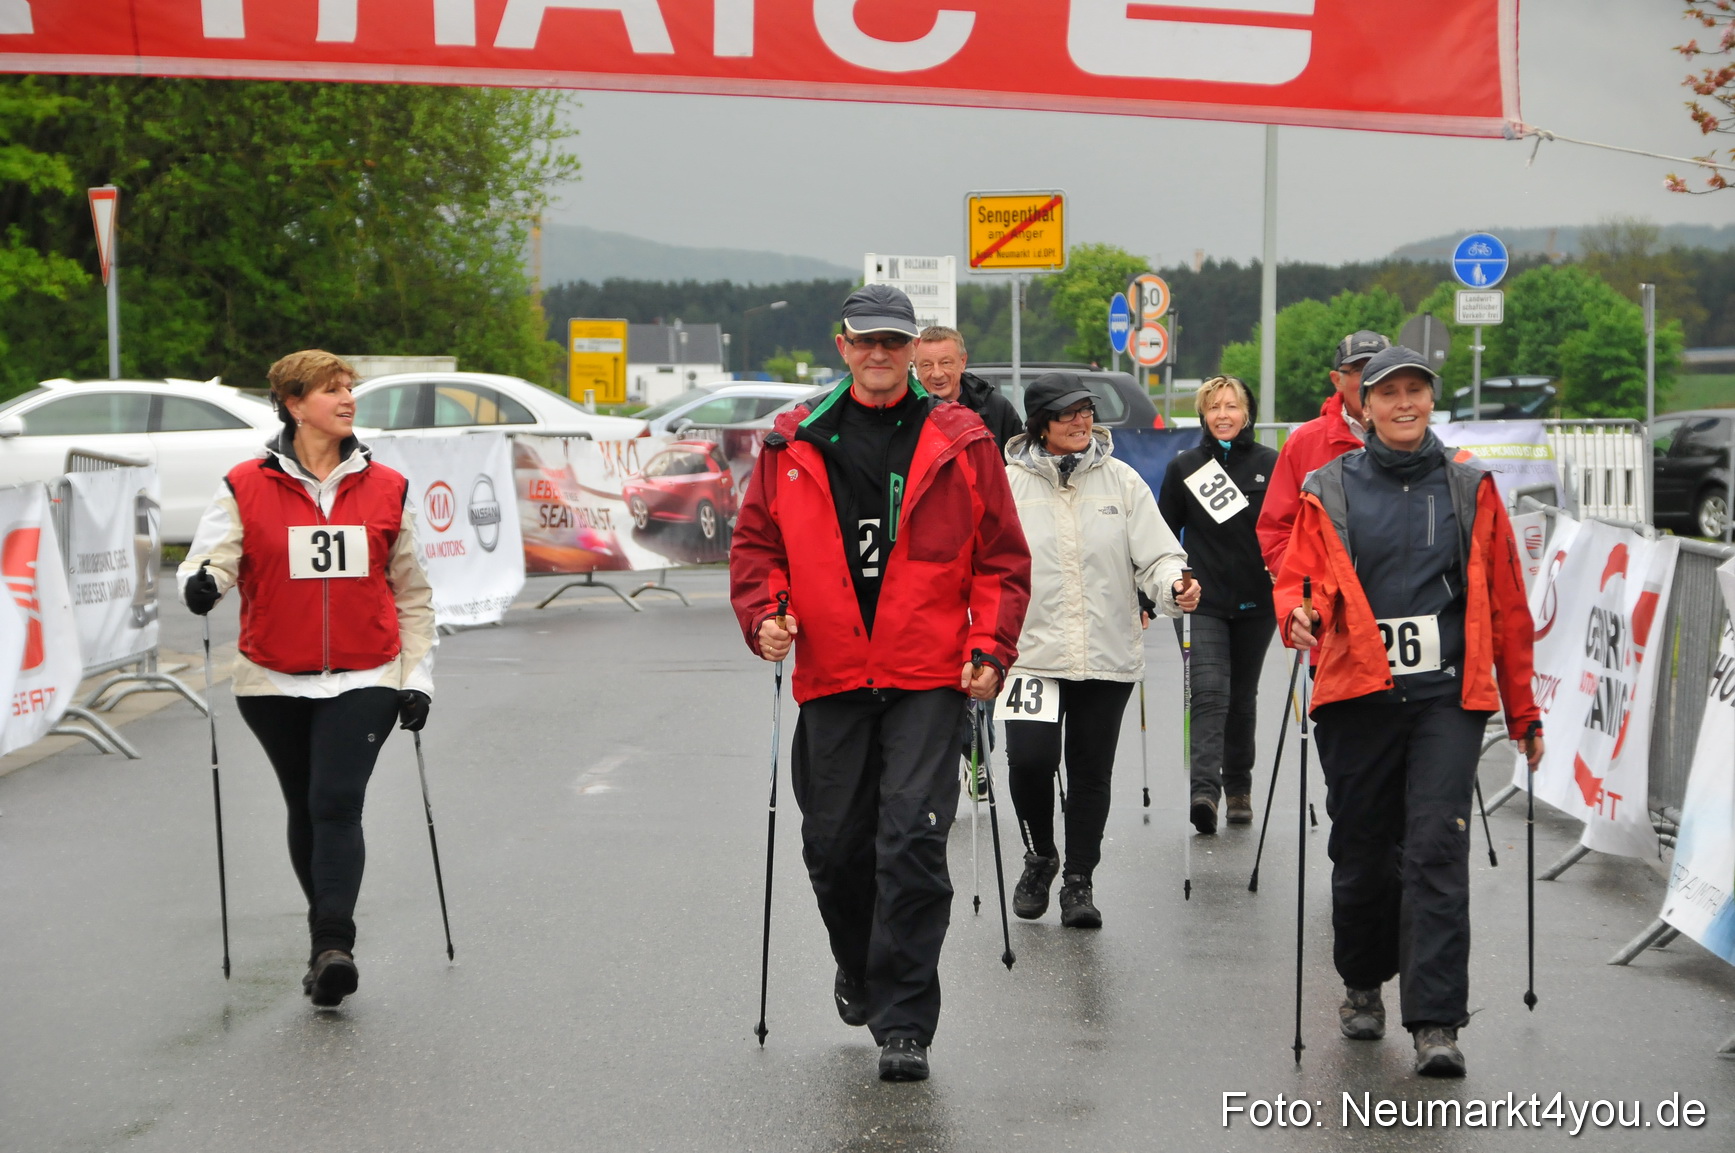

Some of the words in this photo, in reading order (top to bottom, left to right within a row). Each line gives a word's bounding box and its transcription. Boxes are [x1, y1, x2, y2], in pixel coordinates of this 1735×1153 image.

[978, 205, 1055, 227] Sengenthal
[988, 230, 1004, 239] am
[996, 248, 1031, 258] Neumarkt
[1199, 473, 1237, 511] 36
[429, 494, 450, 520] KIA
[471, 507, 498, 520] NISSAN
[311, 530, 346, 573] 31
[425, 544, 436, 559] KIA
[436, 540, 465, 558] MOTORS
[1377, 621, 1421, 668] 26
[1006, 677, 1044, 715] 43
